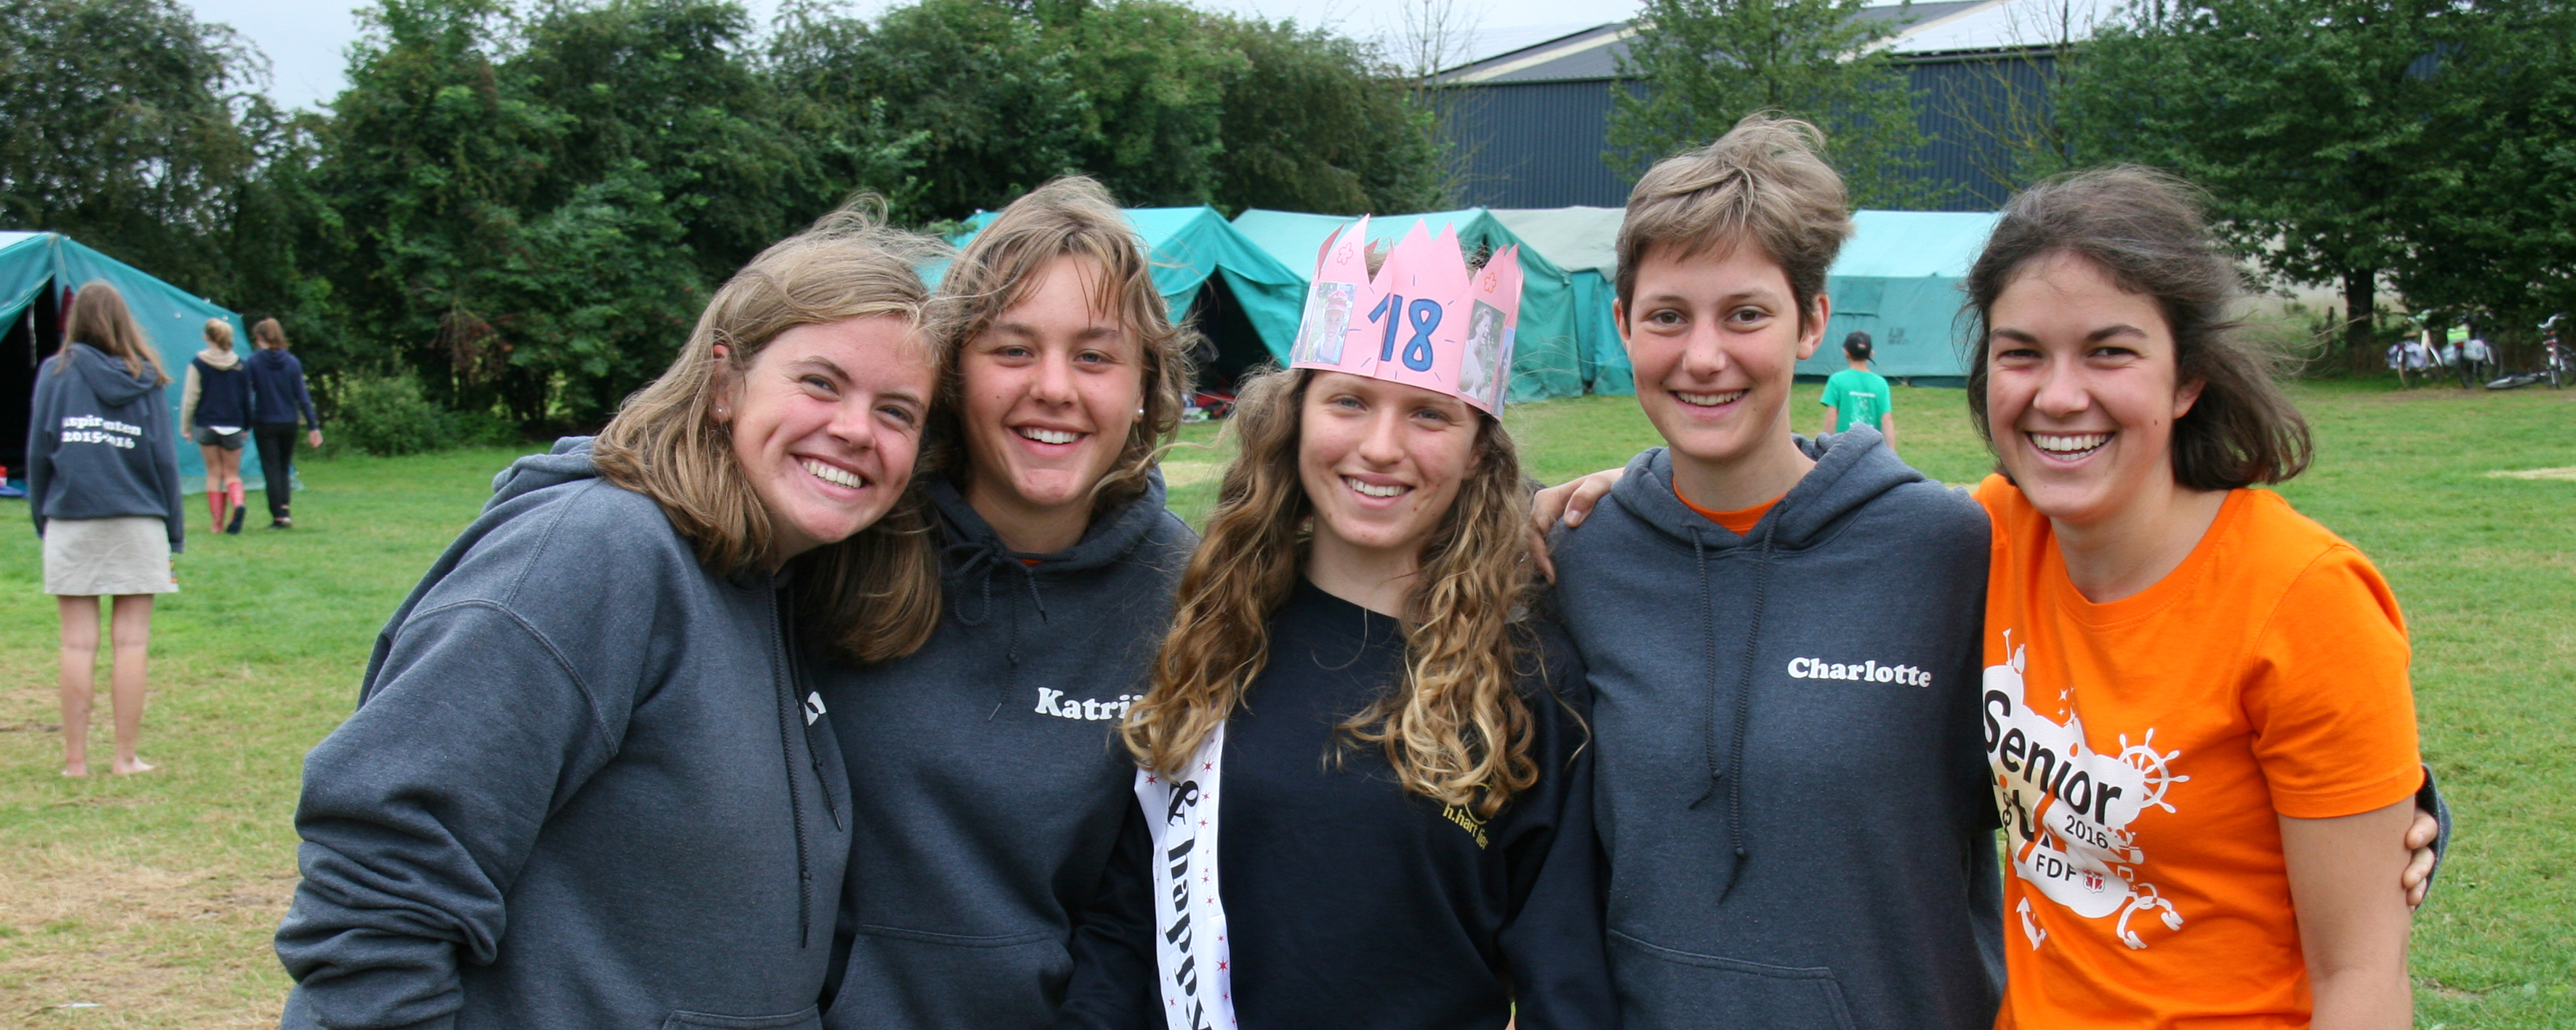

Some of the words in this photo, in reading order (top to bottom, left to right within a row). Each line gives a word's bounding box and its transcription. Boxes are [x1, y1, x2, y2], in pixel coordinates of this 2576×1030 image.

[1368, 292, 1443, 372] 18
[61, 414, 142, 436] spirnten
[1787, 656, 1932, 688] Charlotte
[1983, 689, 2123, 826] Senior
[1167, 779, 1199, 827] &
[2064, 814, 2109, 850] 2016
[2035, 853, 2077, 882] FDF
